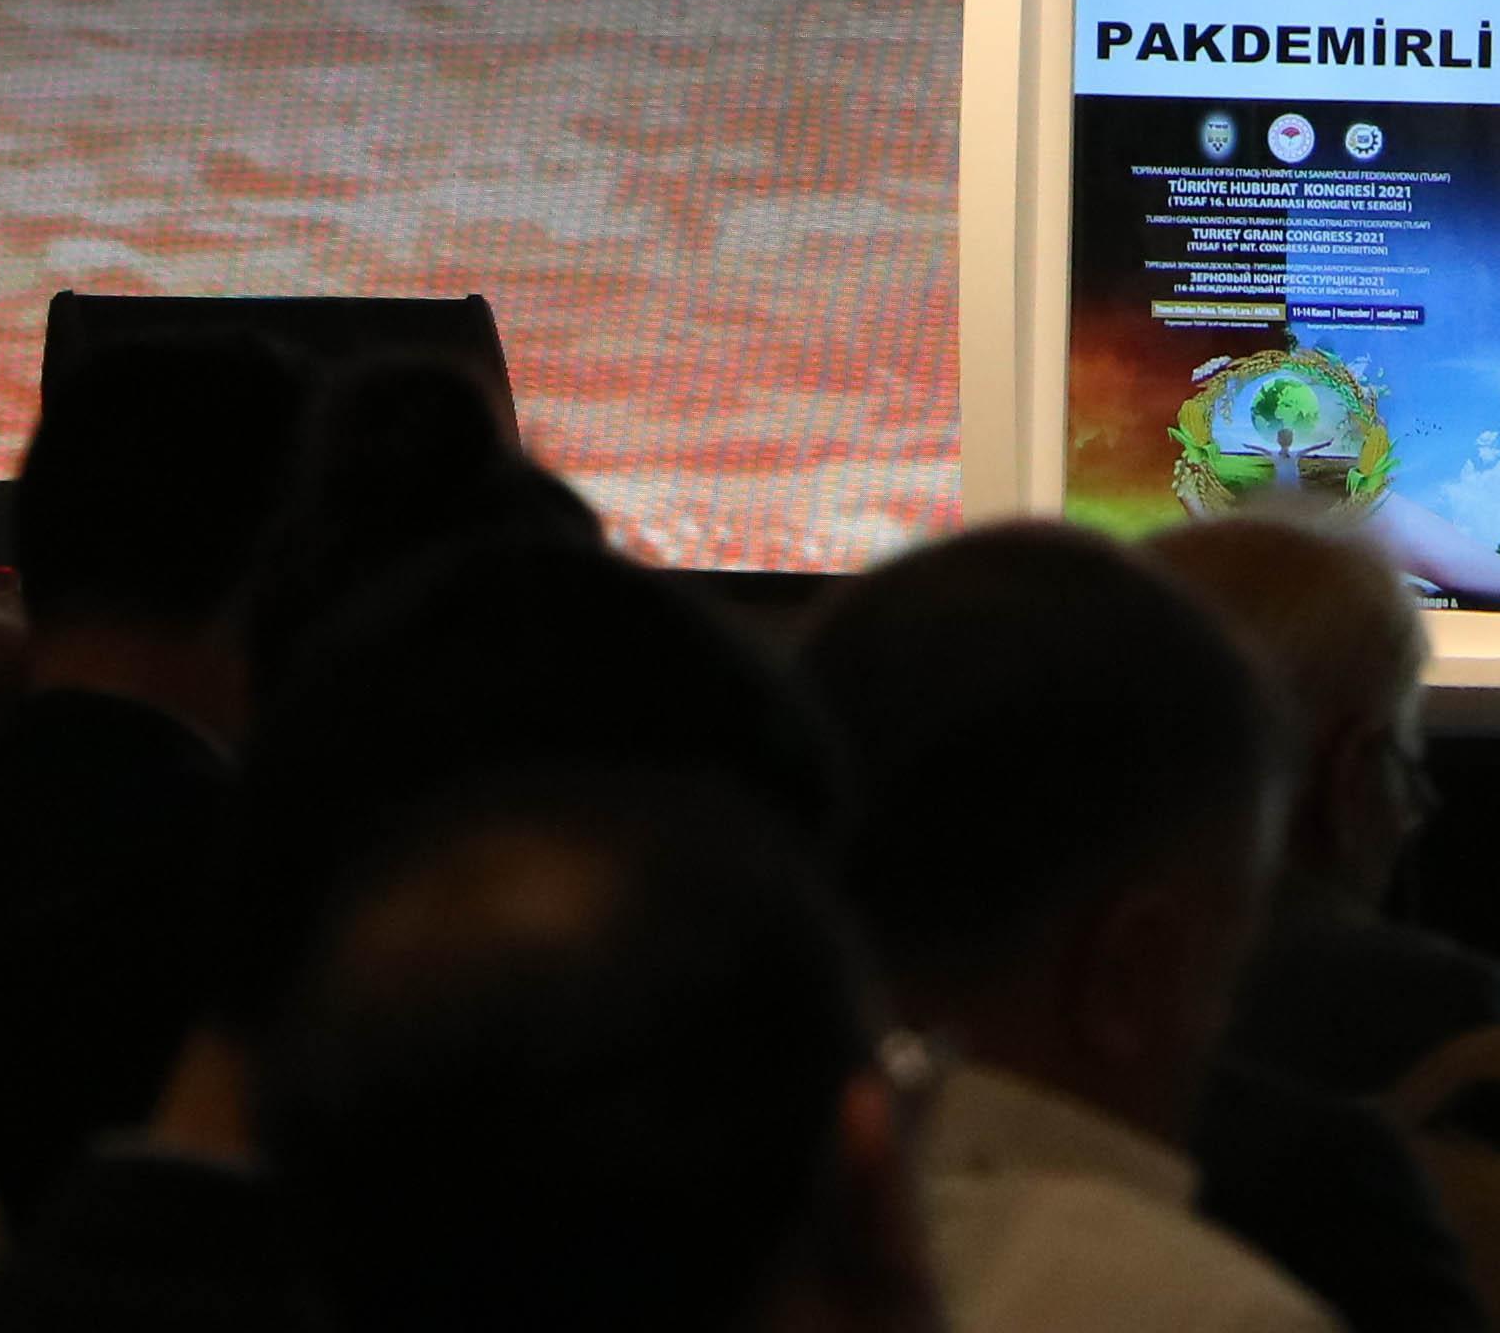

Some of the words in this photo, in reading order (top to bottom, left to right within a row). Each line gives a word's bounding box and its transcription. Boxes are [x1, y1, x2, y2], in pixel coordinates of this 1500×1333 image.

[1096, 17, 1494, 70] PAKDEMİRLİ
[1168, 178, 1228, 195] TÜRKİYE
[1231, 182, 1298, 196] HUBUBAT
[1304, 182, 1375, 198] KONGRESİ
[1378, 185, 1412, 198] 2021
[1174, 196, 1207, 207] TUSAF
[1307, 199, 1349, 210] KONGRE
[1351, 200, 1366, 211] VE
[1192, 228, 1241, 240] TURKEY
[1243, 229, 1283, 242] GRAIN
[1286, 230, 1353, 244] CONGRESS
[1355, 232, 1385, 244] 2021
[1253, 273, 1312, 286] КОНГРЕСС
[1359, 276, 1385, 288] 2021
